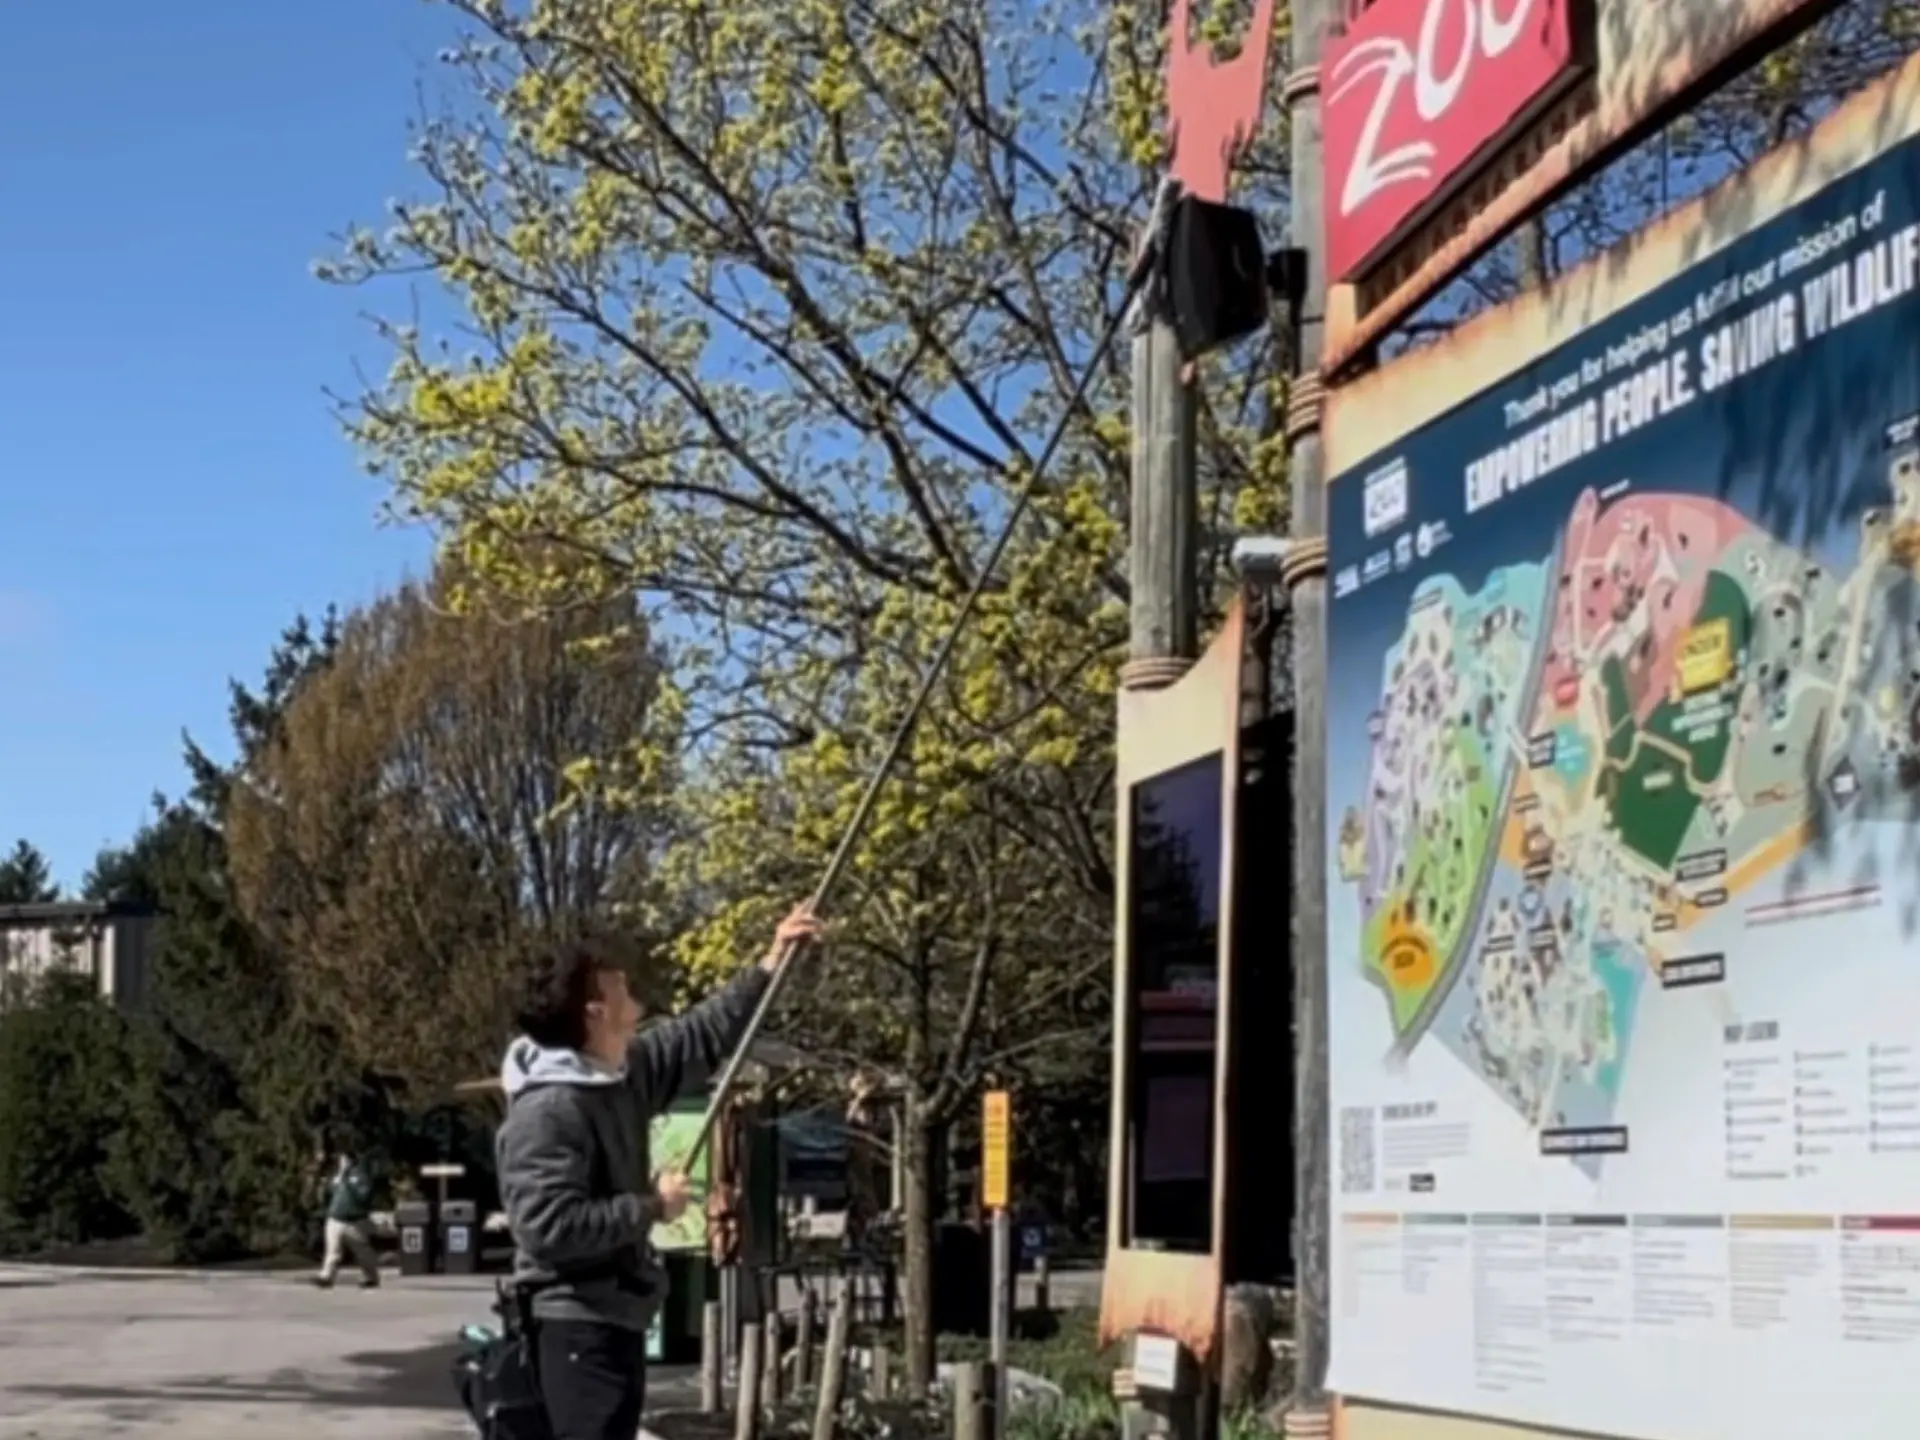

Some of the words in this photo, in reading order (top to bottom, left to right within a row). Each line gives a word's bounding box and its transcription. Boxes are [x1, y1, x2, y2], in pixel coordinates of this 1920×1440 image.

[1464, 397, 1598, 514] EMPOWERING
[1602, 348, 1697, 443] PEOPLE.
[1701, 293, 1796, 392] SAVING
[1802, 222, 1920, 341] WILDLIF
[1503, 385, 1548, 429] Thank
[1550, 373, 1580, 411] you
[1582, 357, 1603, 385] for
[1606, 321, 1669, 374] helping
[1670, 307, 1693, 338] us
[1742, 260, 1775, 296] our
[1778, 214, 1858, 278] mission
[1860, 189, 1886, 231] of
